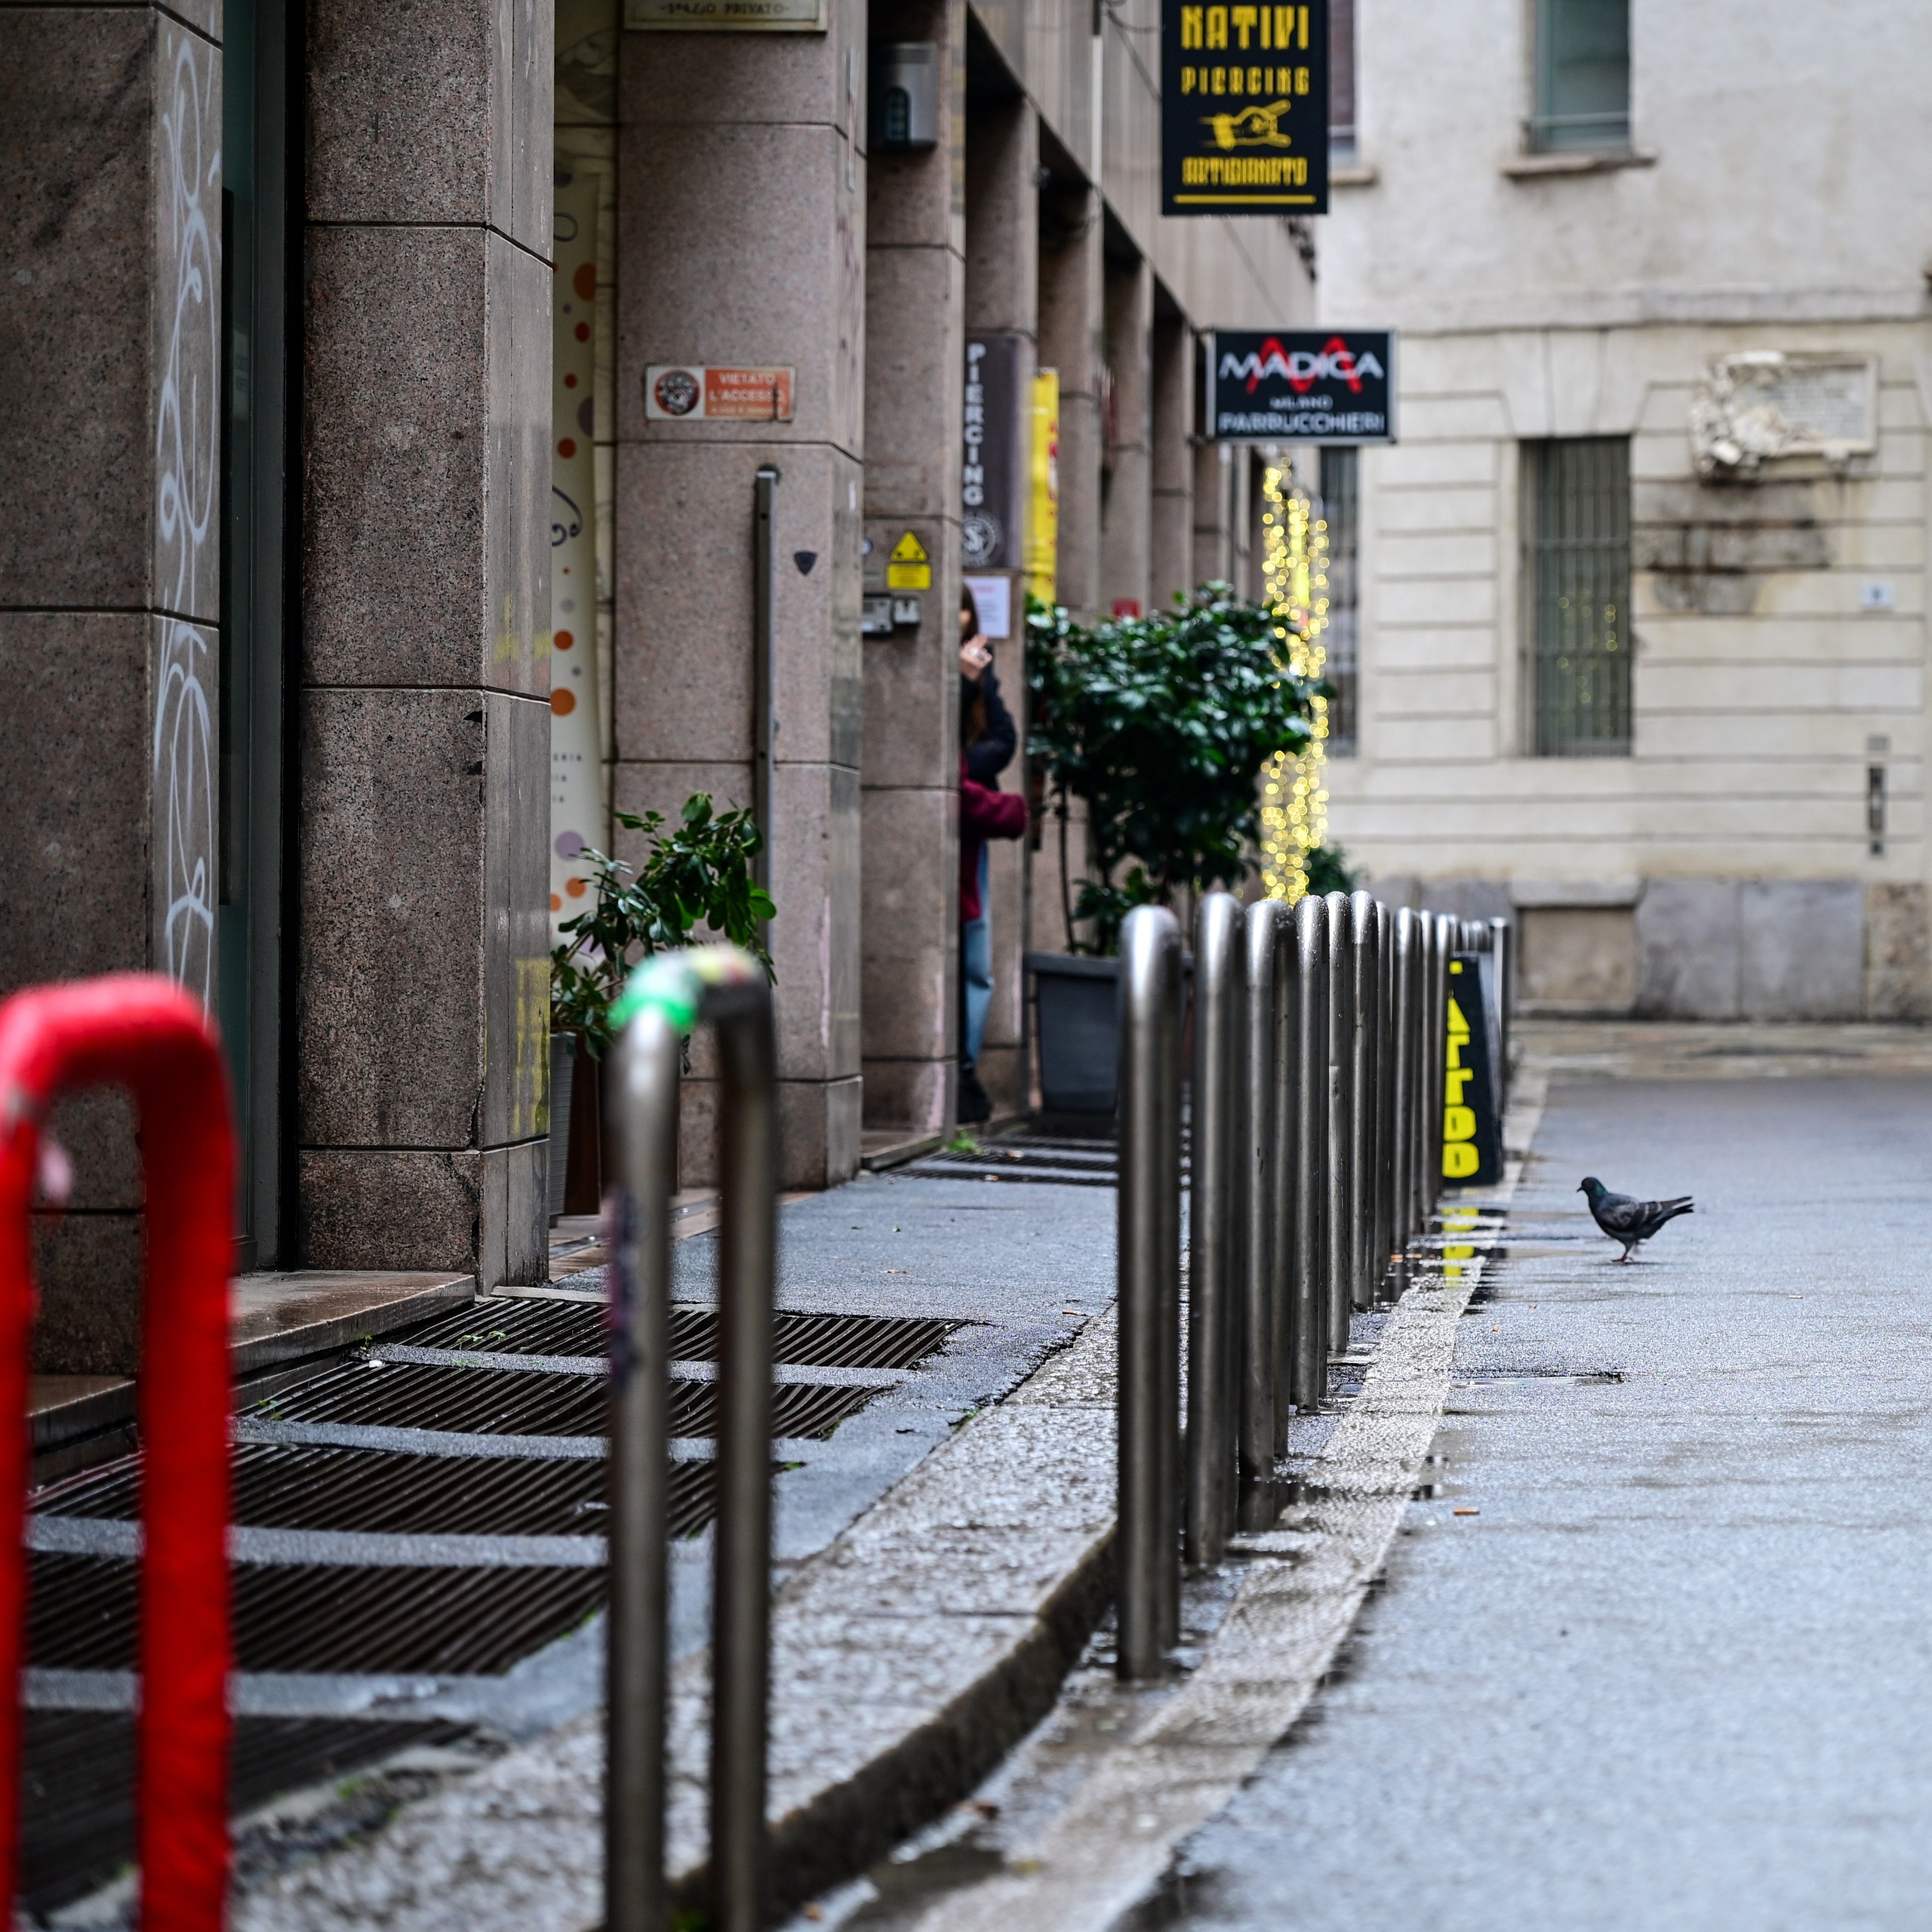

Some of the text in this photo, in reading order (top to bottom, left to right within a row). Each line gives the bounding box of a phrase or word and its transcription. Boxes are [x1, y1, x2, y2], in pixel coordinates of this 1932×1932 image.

[1180, 5, 1309, 50] NATIVI
[1180, 66, 1309, 95] PIERCING
[1182, 157, 1308, 186] ARTIGIANATO
[718, 372, 777, 385] VIETATO
[1218, 348, 1385, 381] MADICA
[1269, 395, 1334, 411] MILANO
[963, 343, 986, 506] PIERCING
[1218, 412, 1385, 434] PARRUCCHIERI
